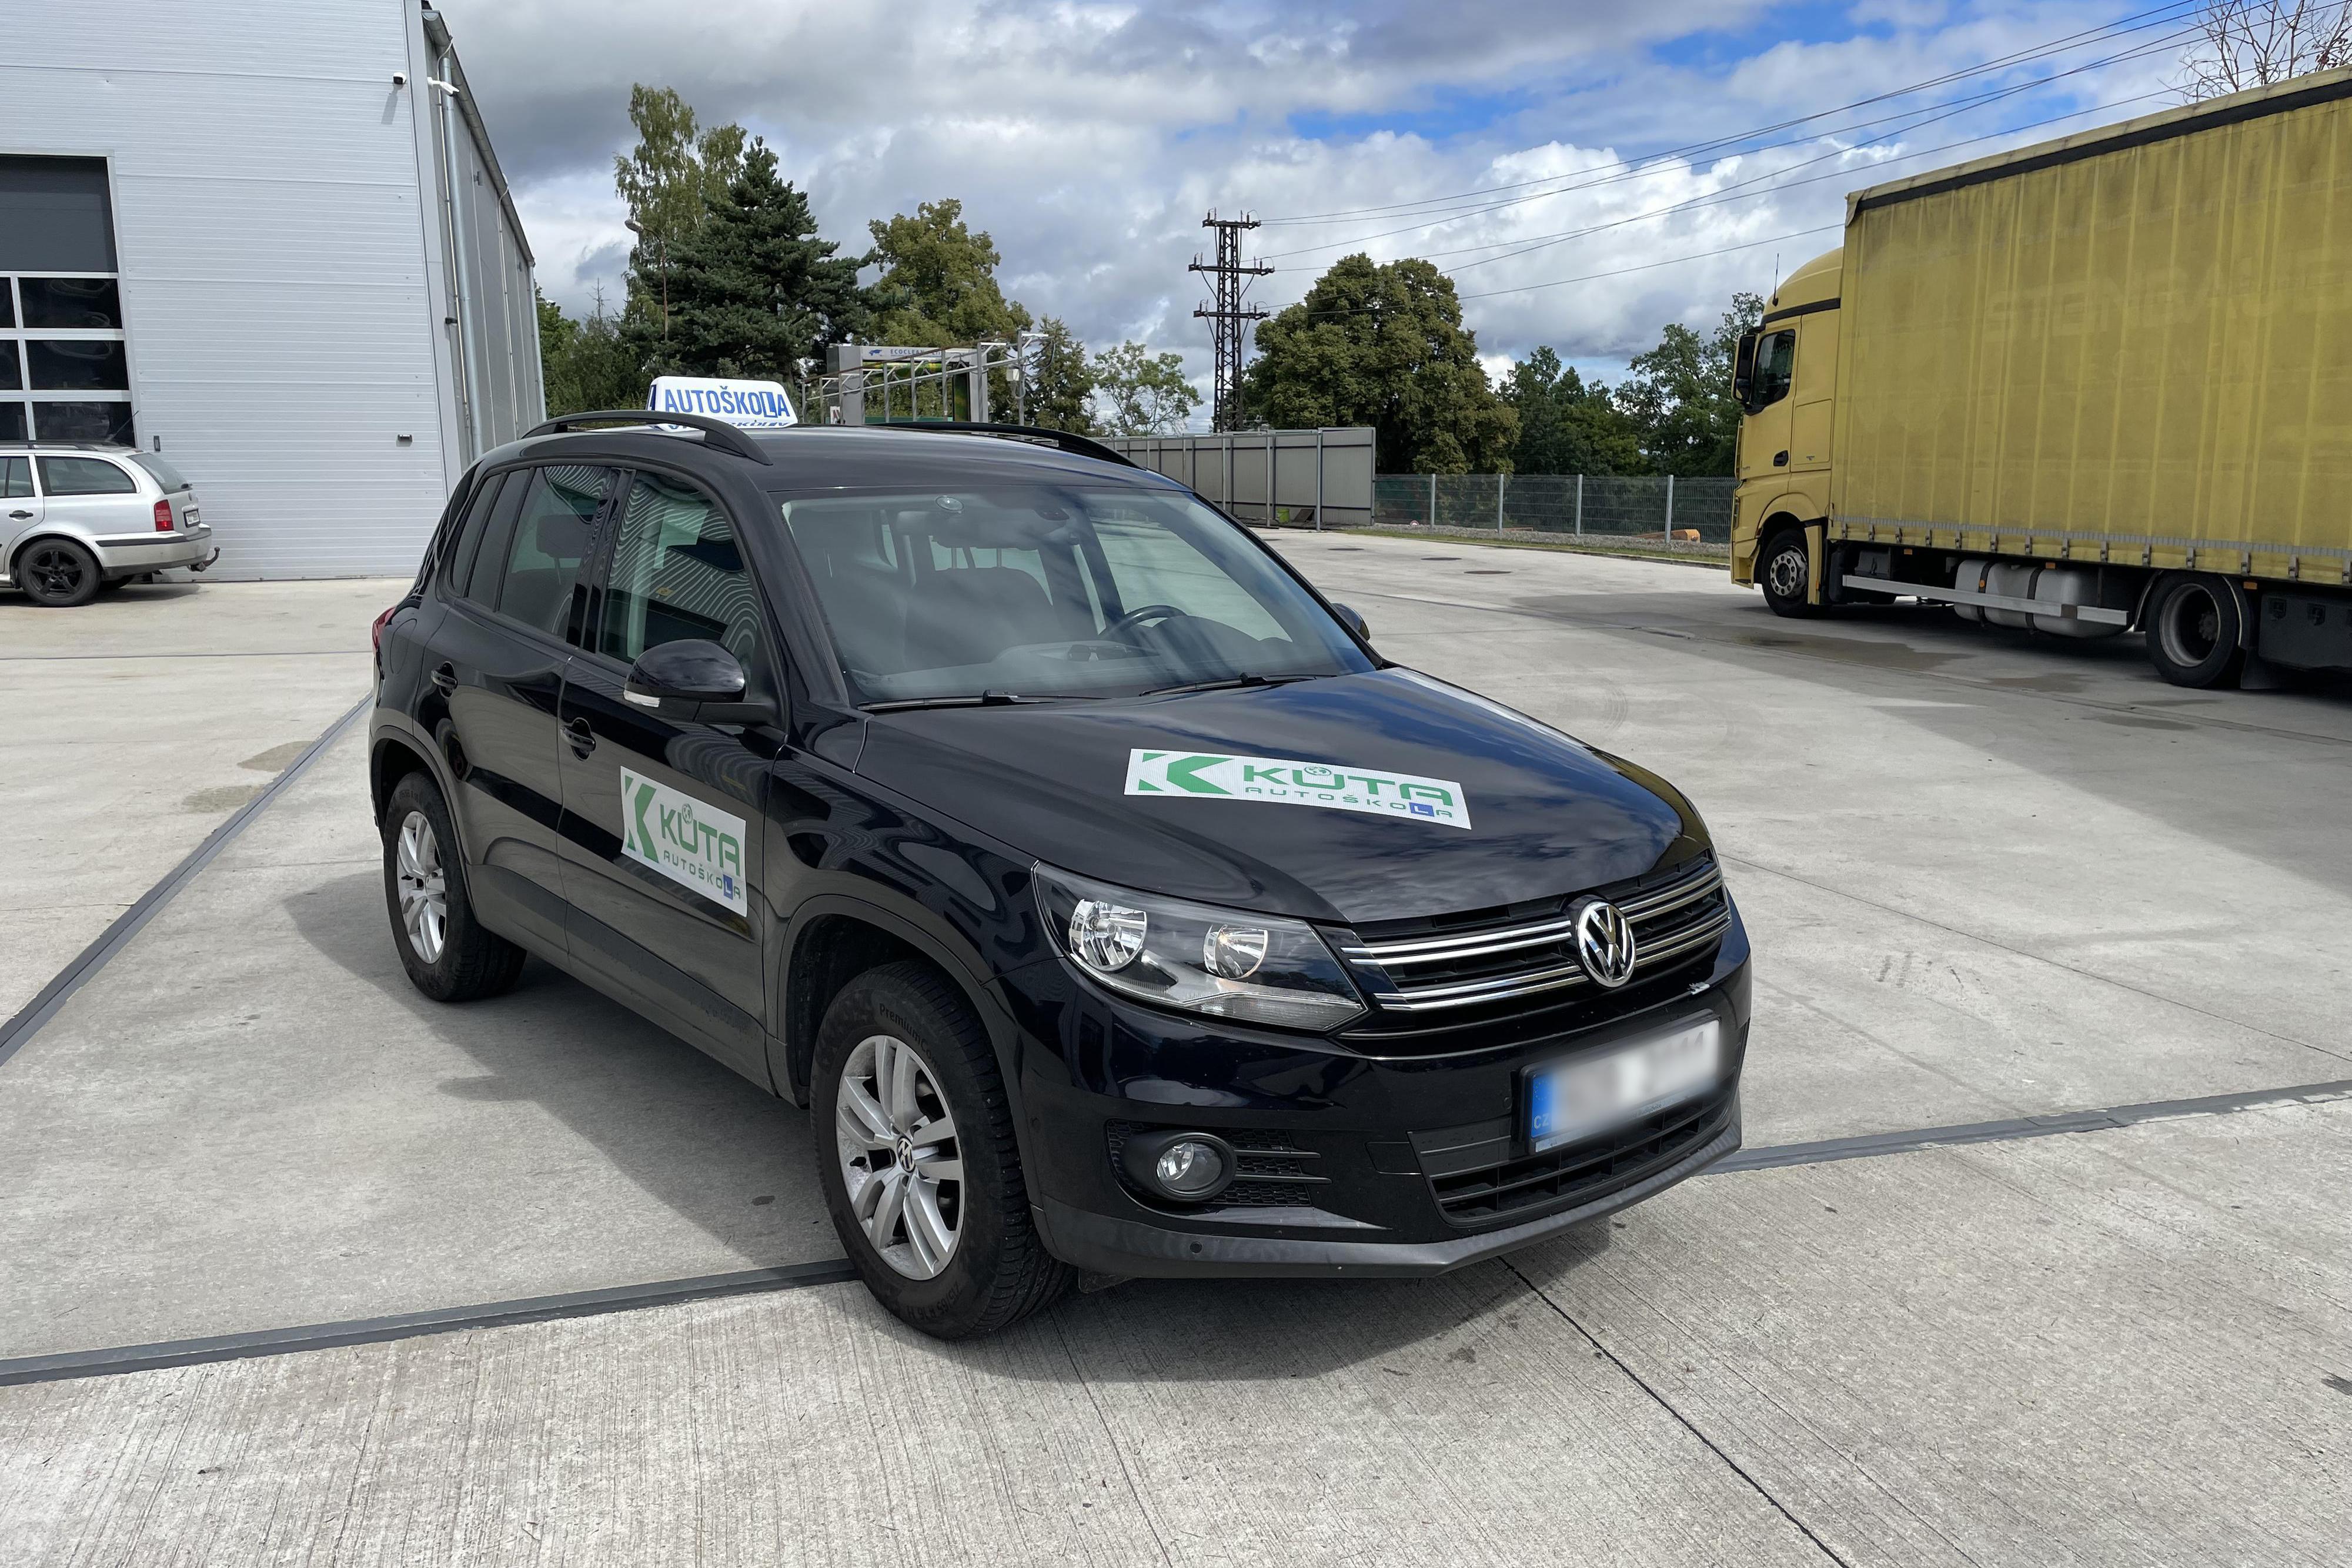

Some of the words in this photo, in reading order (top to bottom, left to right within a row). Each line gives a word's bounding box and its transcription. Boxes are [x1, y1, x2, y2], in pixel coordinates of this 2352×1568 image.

[665, 386, 790, 418] AUTOŠKOLA
[1245, 787, 1453, 818] AUTOŠKOLA
[663, 850, 741, 900] AUTOŠKOLA
